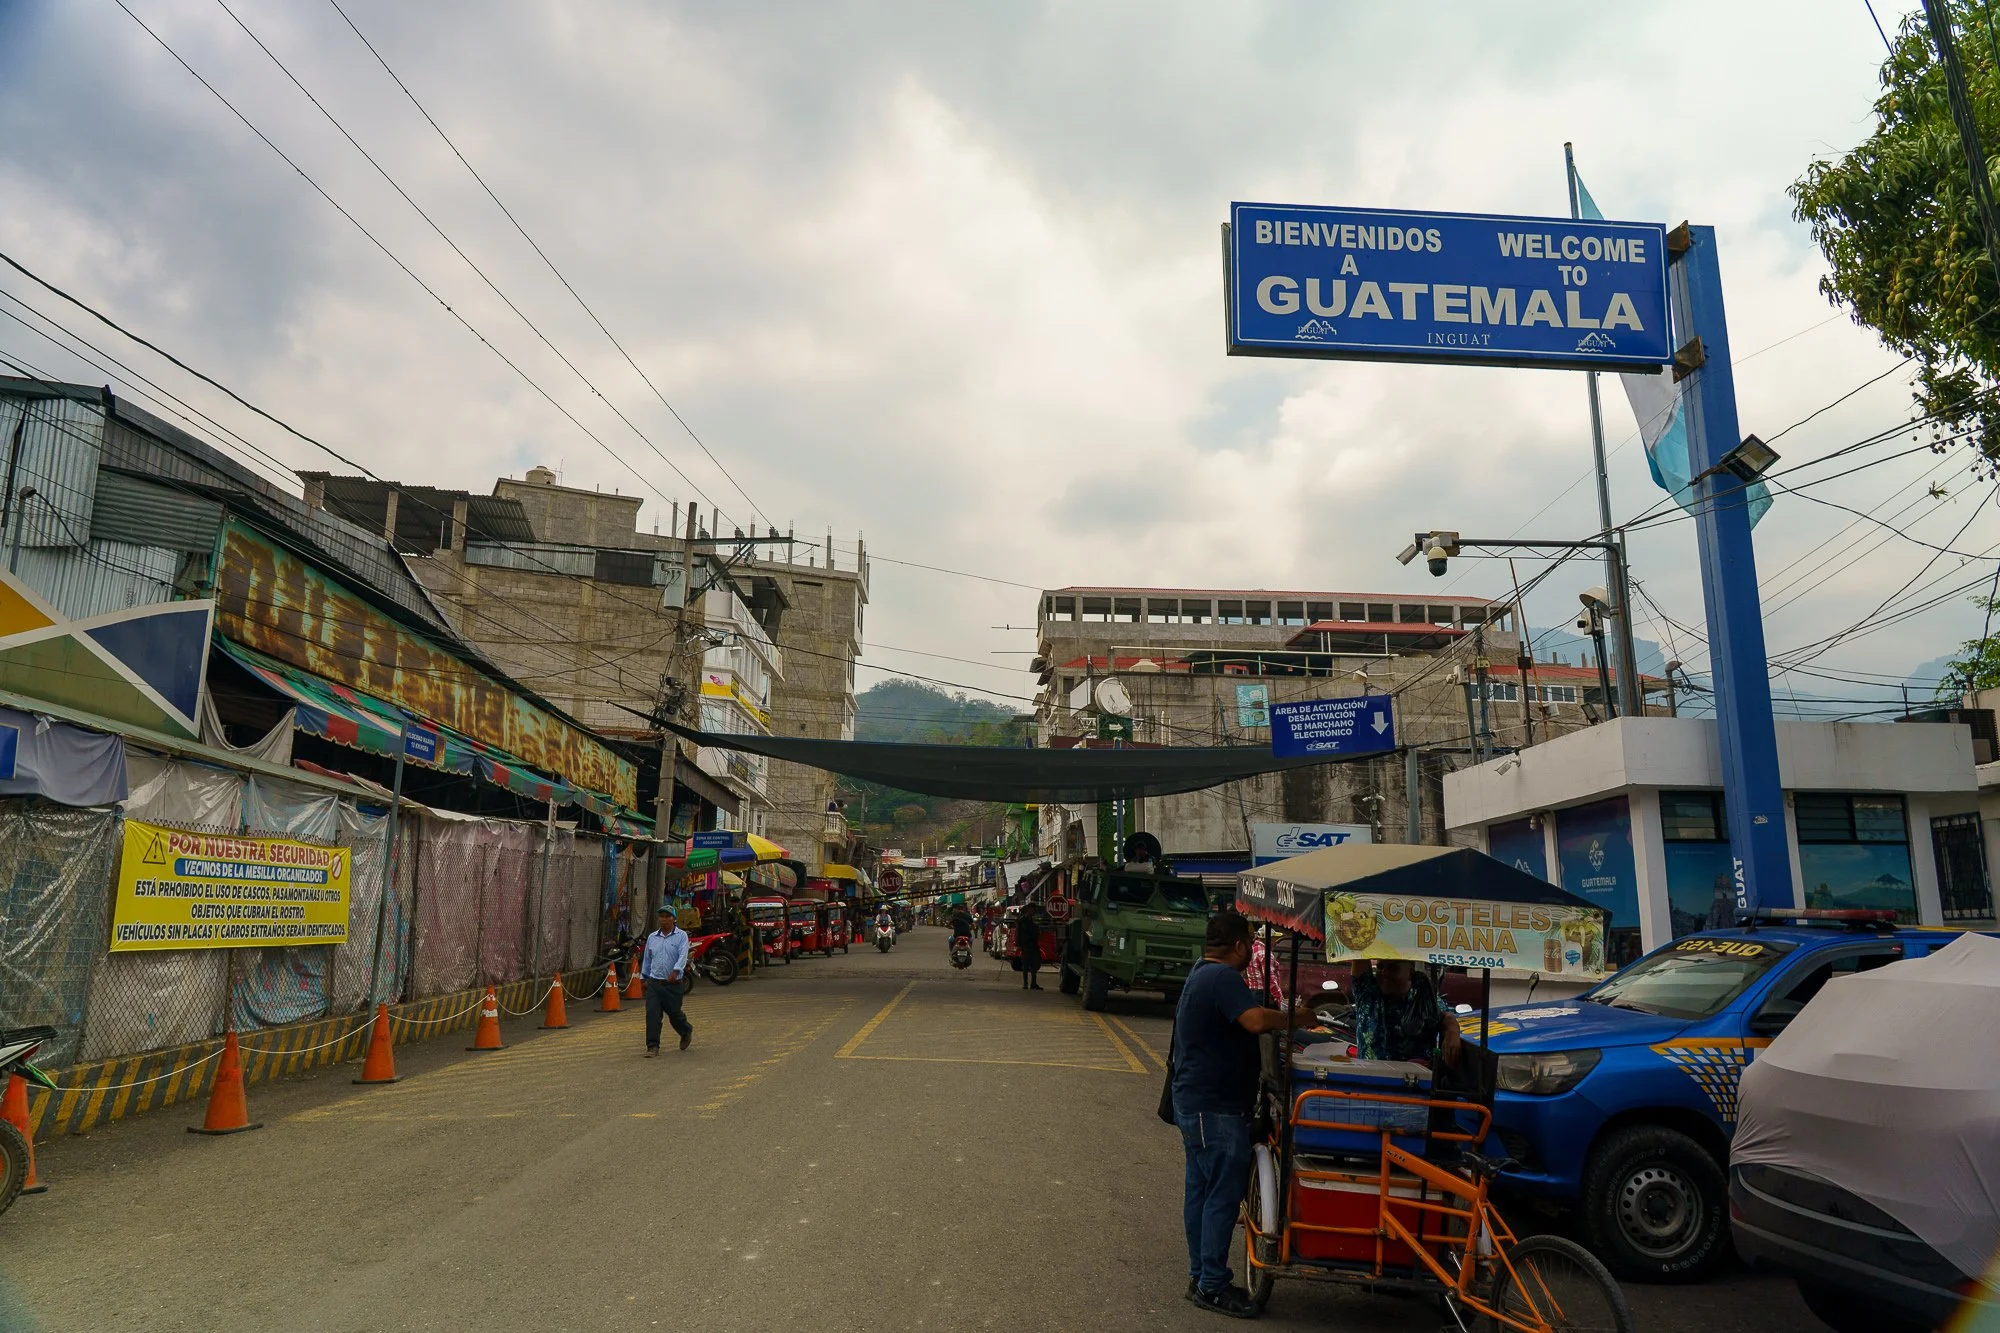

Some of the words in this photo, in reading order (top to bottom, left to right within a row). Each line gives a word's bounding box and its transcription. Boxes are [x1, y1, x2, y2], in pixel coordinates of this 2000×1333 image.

[1255, 219, 1442, 253] BIENVENIDOS
[1497, 232, 1645, 263] WELCOME
[1340, 254, 1359, 276] A
[1558, 265, 1588, 286] TO
[1256, 275, 1644, 331] GUATEMALA
[1427, 332, 1491, 346] INGUAT
[1275, 706, 1298, 716] ÁREA
[1299, 705, 1311, 714] DE
[1312, 700, 1368, 714] ACTIVACIÓN/
[1288, 710, 1356, 723] DESACTIVACIÓN
[1291, 723, 1303, 731] DE
[1304, 720, 1354, 731] MARCHAMO
[1293, 728, 1353, 739] ELECTRÓNICO
[1315, 741, 1340, 750] SAT
[1296, 832, 1351, 848] SAT
[168, 832, 201, 855] POR
[204, 837, 267, 862] NUESTRA
[269, 844, 330, 867] SEGURIDAD
[184, 860, 221, 877] VECINOS
[222, 863, 233, 878] DE
[233, 864, 244, 879] LA
[246, 865, 276, 880] MESILLA
[277, 867, 323, 883] ORGANIZADOS
[135, 878, 156, 896] ESTÁ
[158, 882, 203, 898] PRHOIBIDO
[205, 884, 214, 898] EL
[215, 885, 231, 899] USO
[232, 886, 243, 900] DE
[243, 886, 271, 901] CASCOS,
[272, 886, 320, 901] PASAMONTAÑAS
[320, 890, 326, 901] U
[325, 890, 341, 902] OTROS
[881, 876, 900, 888] ALTO
[1581, 876, 1617, 888] GUATEMALA
[1733, 857, 1747, 920] GUAT
[191, 905, 225, 919] OBJETOS
[226, 905, 242, 921] QUE
[242, 905, 271, 919] CUBRAN
[271, 906, 279, 919] EL
[280, 906, 306, 919] ROSTRO.
[1048, 904, 1068, 912] ALTO
[1382, 898, 1552, 932] COCTELES
[117, 922, 167, 941] VEHÍCULOS
[167, 925, 182, 940] SIN
[184, 925, 213, 940] PLACAS
[213, 925, 219, 939] Y
[220, 924, 250, 939] CARROS
[251, 922, 285, 938] EXTRAÑOS
[286, 922, 306, 937] SERÁN
[1416, 924, 1518, 954] DIANA
[1428, 952, 1505, 969] 5553-2494
